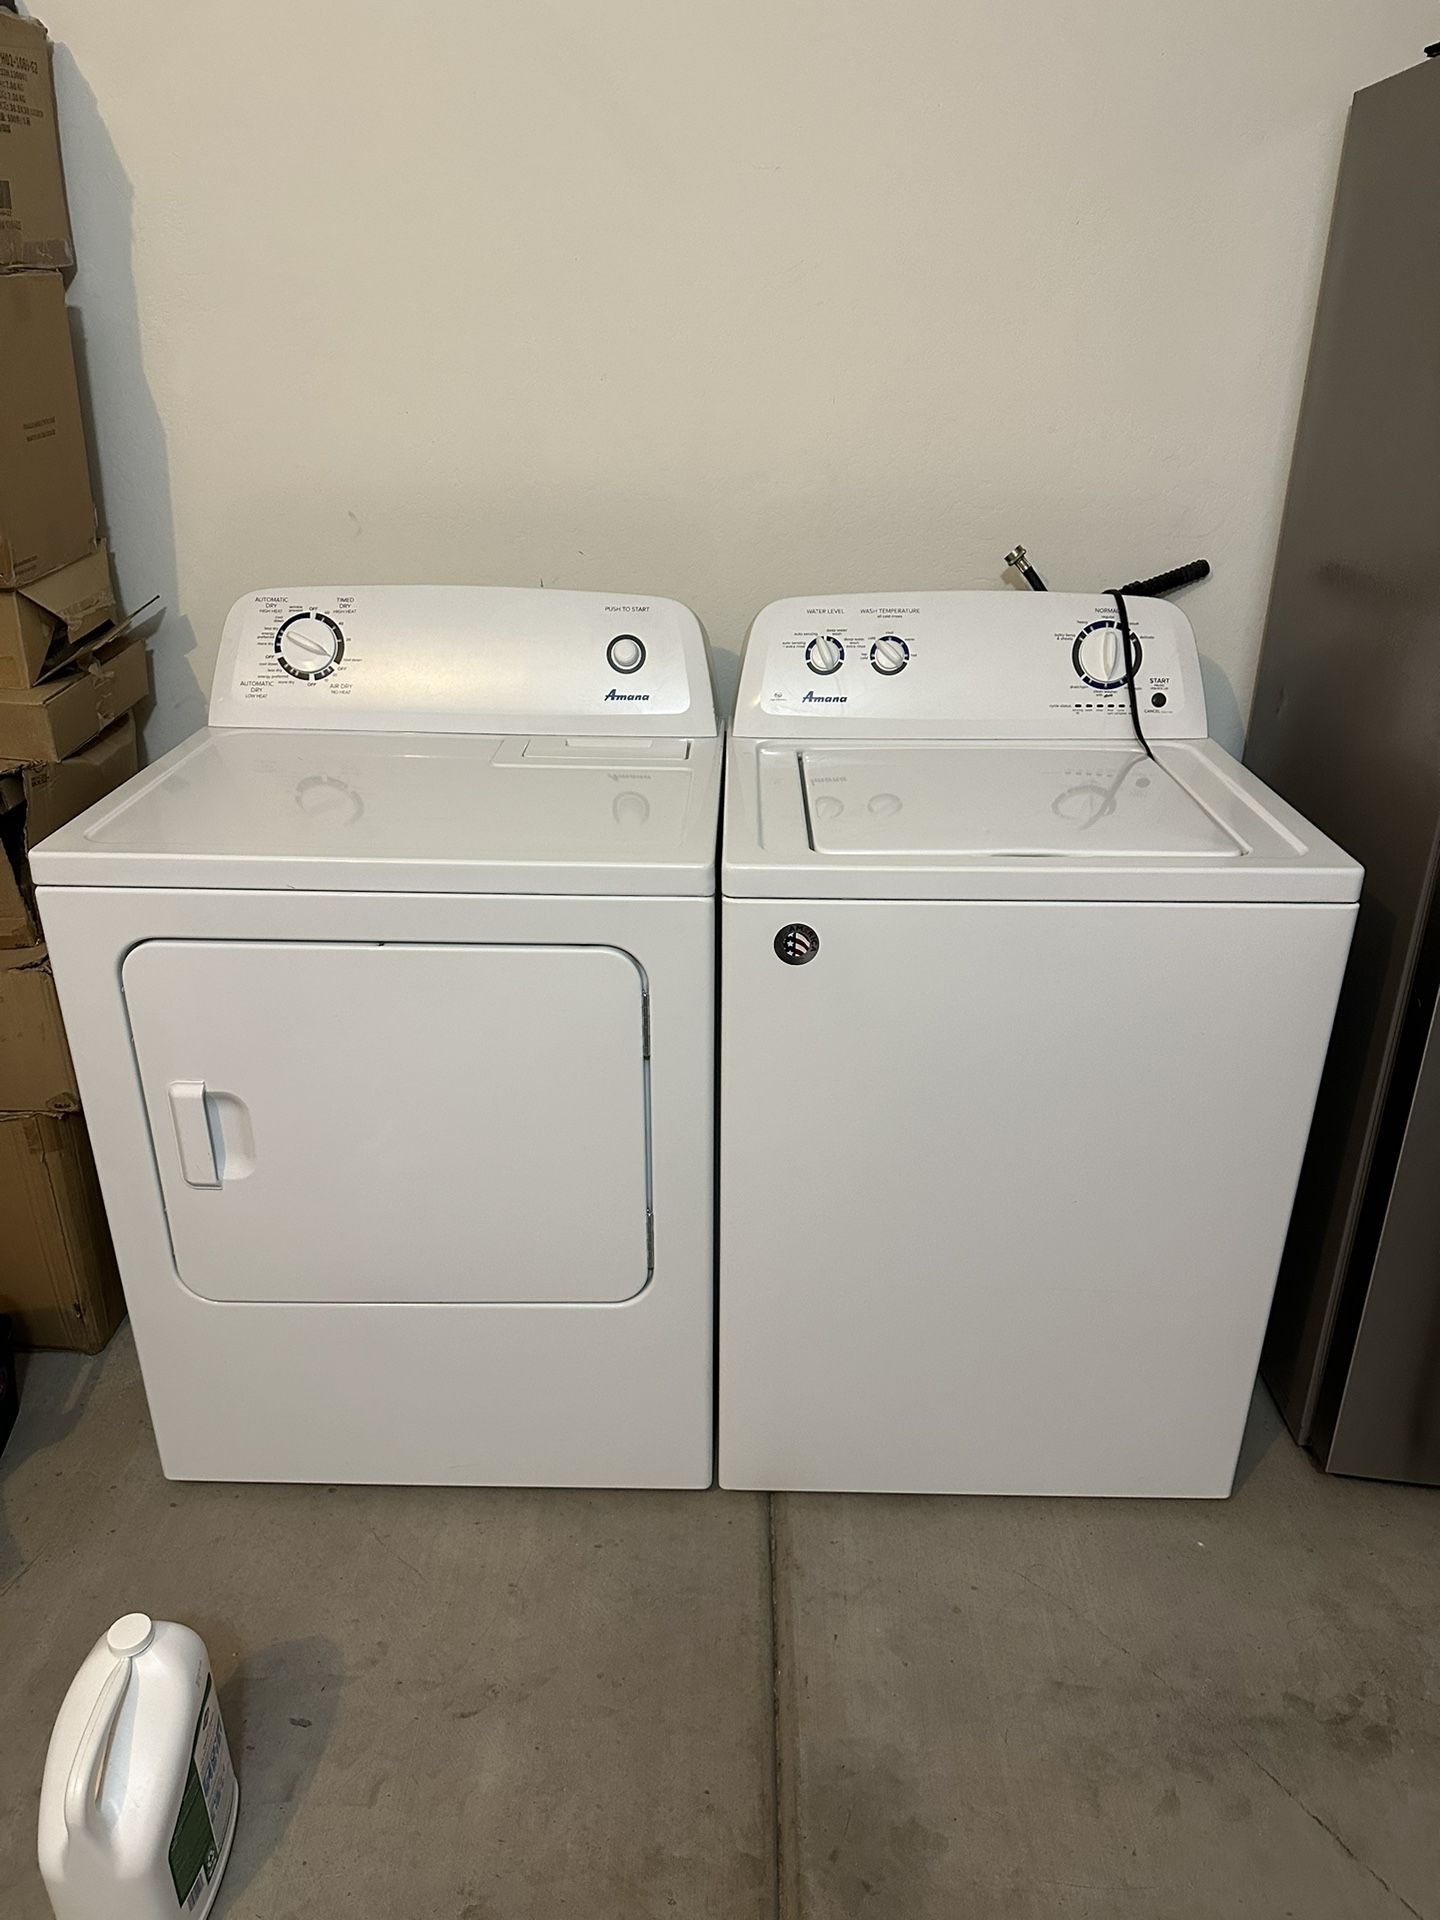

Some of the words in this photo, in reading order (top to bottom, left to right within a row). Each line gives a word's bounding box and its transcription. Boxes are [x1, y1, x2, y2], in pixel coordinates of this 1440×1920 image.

[604, 689, 650, 701] Amana
[802, 691, 848, 703] Amana
[789, 925, 818, 951] AMERICA
